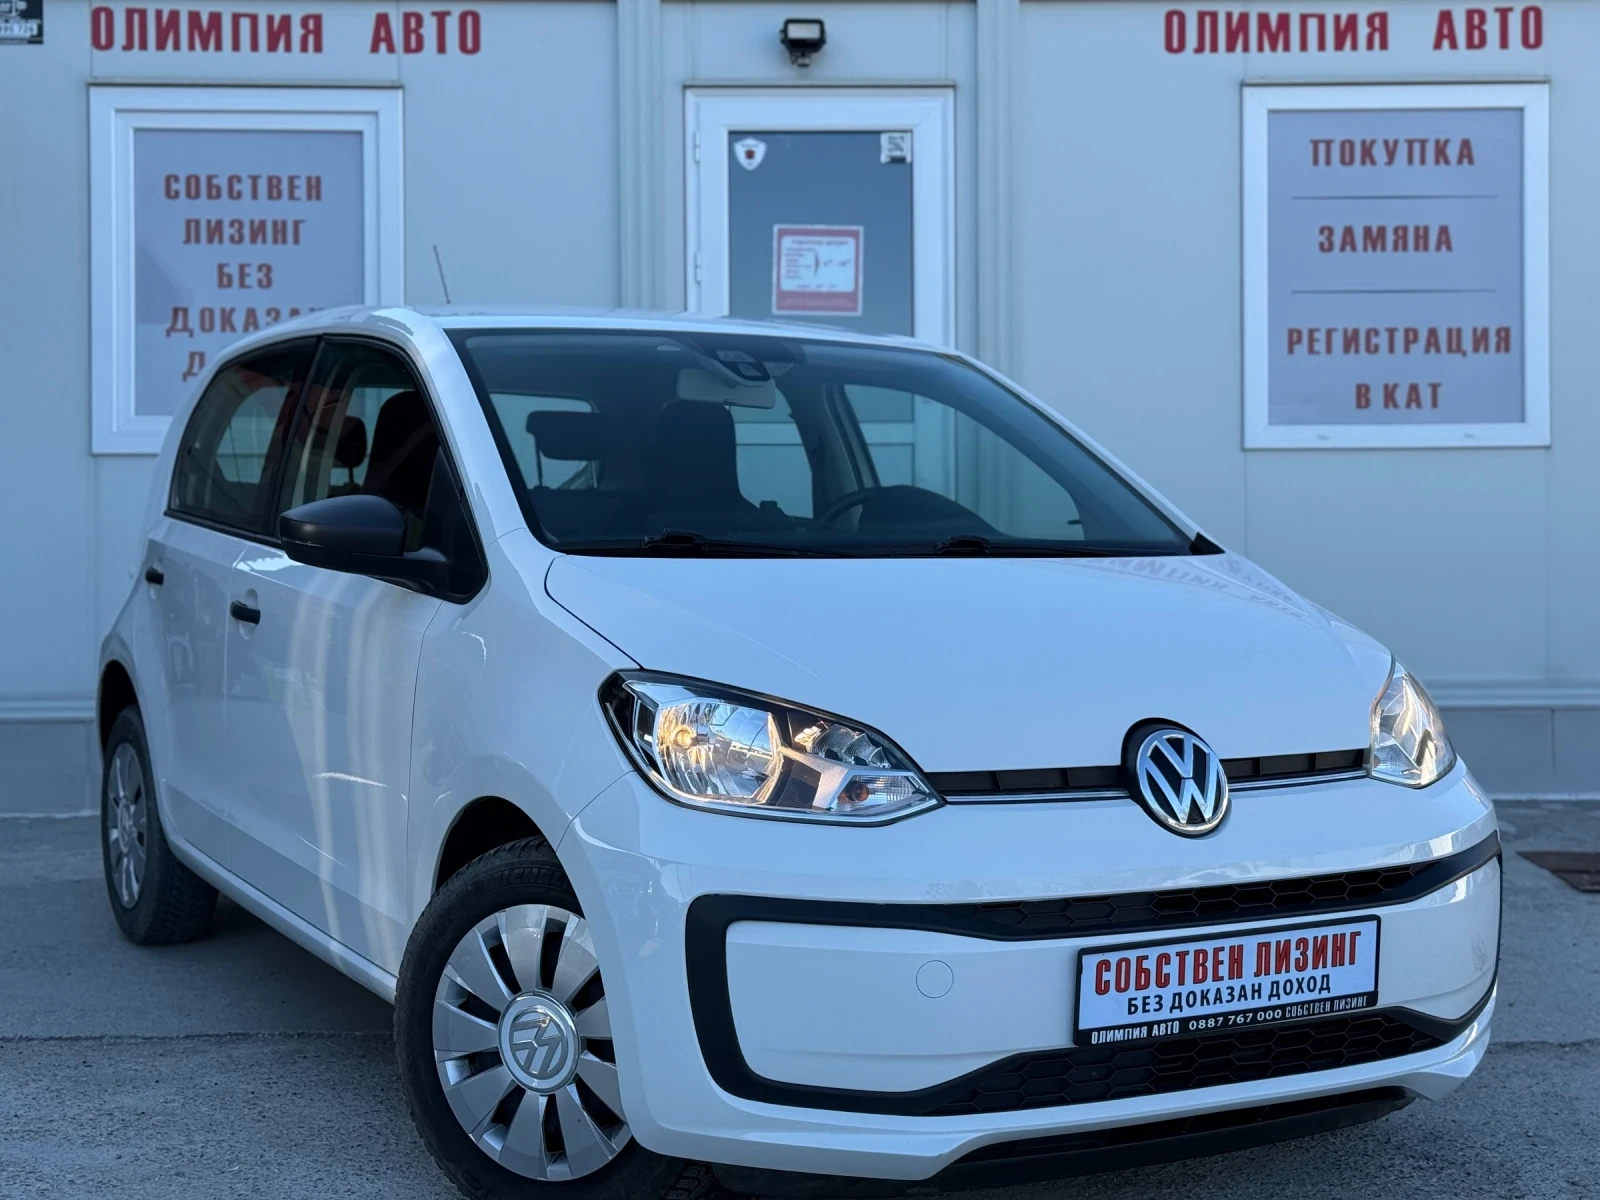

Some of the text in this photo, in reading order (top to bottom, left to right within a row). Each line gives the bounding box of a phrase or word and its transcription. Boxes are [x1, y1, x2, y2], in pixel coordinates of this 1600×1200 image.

[91, 7, 481, 55] ОЛИМПИЯ АВТО
[1163, 6, 1544, 54] ОЛИМПИЯ АВТО
[1310, 138, 1475, 167] ПОКУПКА
[164, 174, 322, 201] СОБСТВЕН
[183, 219, 305, 246] ЛИЗИНГ
[1318, 225, 1453, 253] ЗАМЯНА
[216, 263, 273, 289] БЕЗ
[166, 306, 325, 338] ДОКАЗ
[1287, 326, 1511, 357] РЕГИСТРАЦИЯ
[1355, 383, 1442, 410] В КАТ
[1138, 729, 1228, 834] VW
[1095, 931, 1361, 995] СОБСТВЕН ЛИЗИНГ
[1127, 974, 1331, 1016] БЕЗ ДОКАЗАН ДОХОД
[1091, 995, 1368, 1045] ОЛИМПИЯ АВТО 0887 767 000 СОБСТВЕН ЛИЗИНГ
